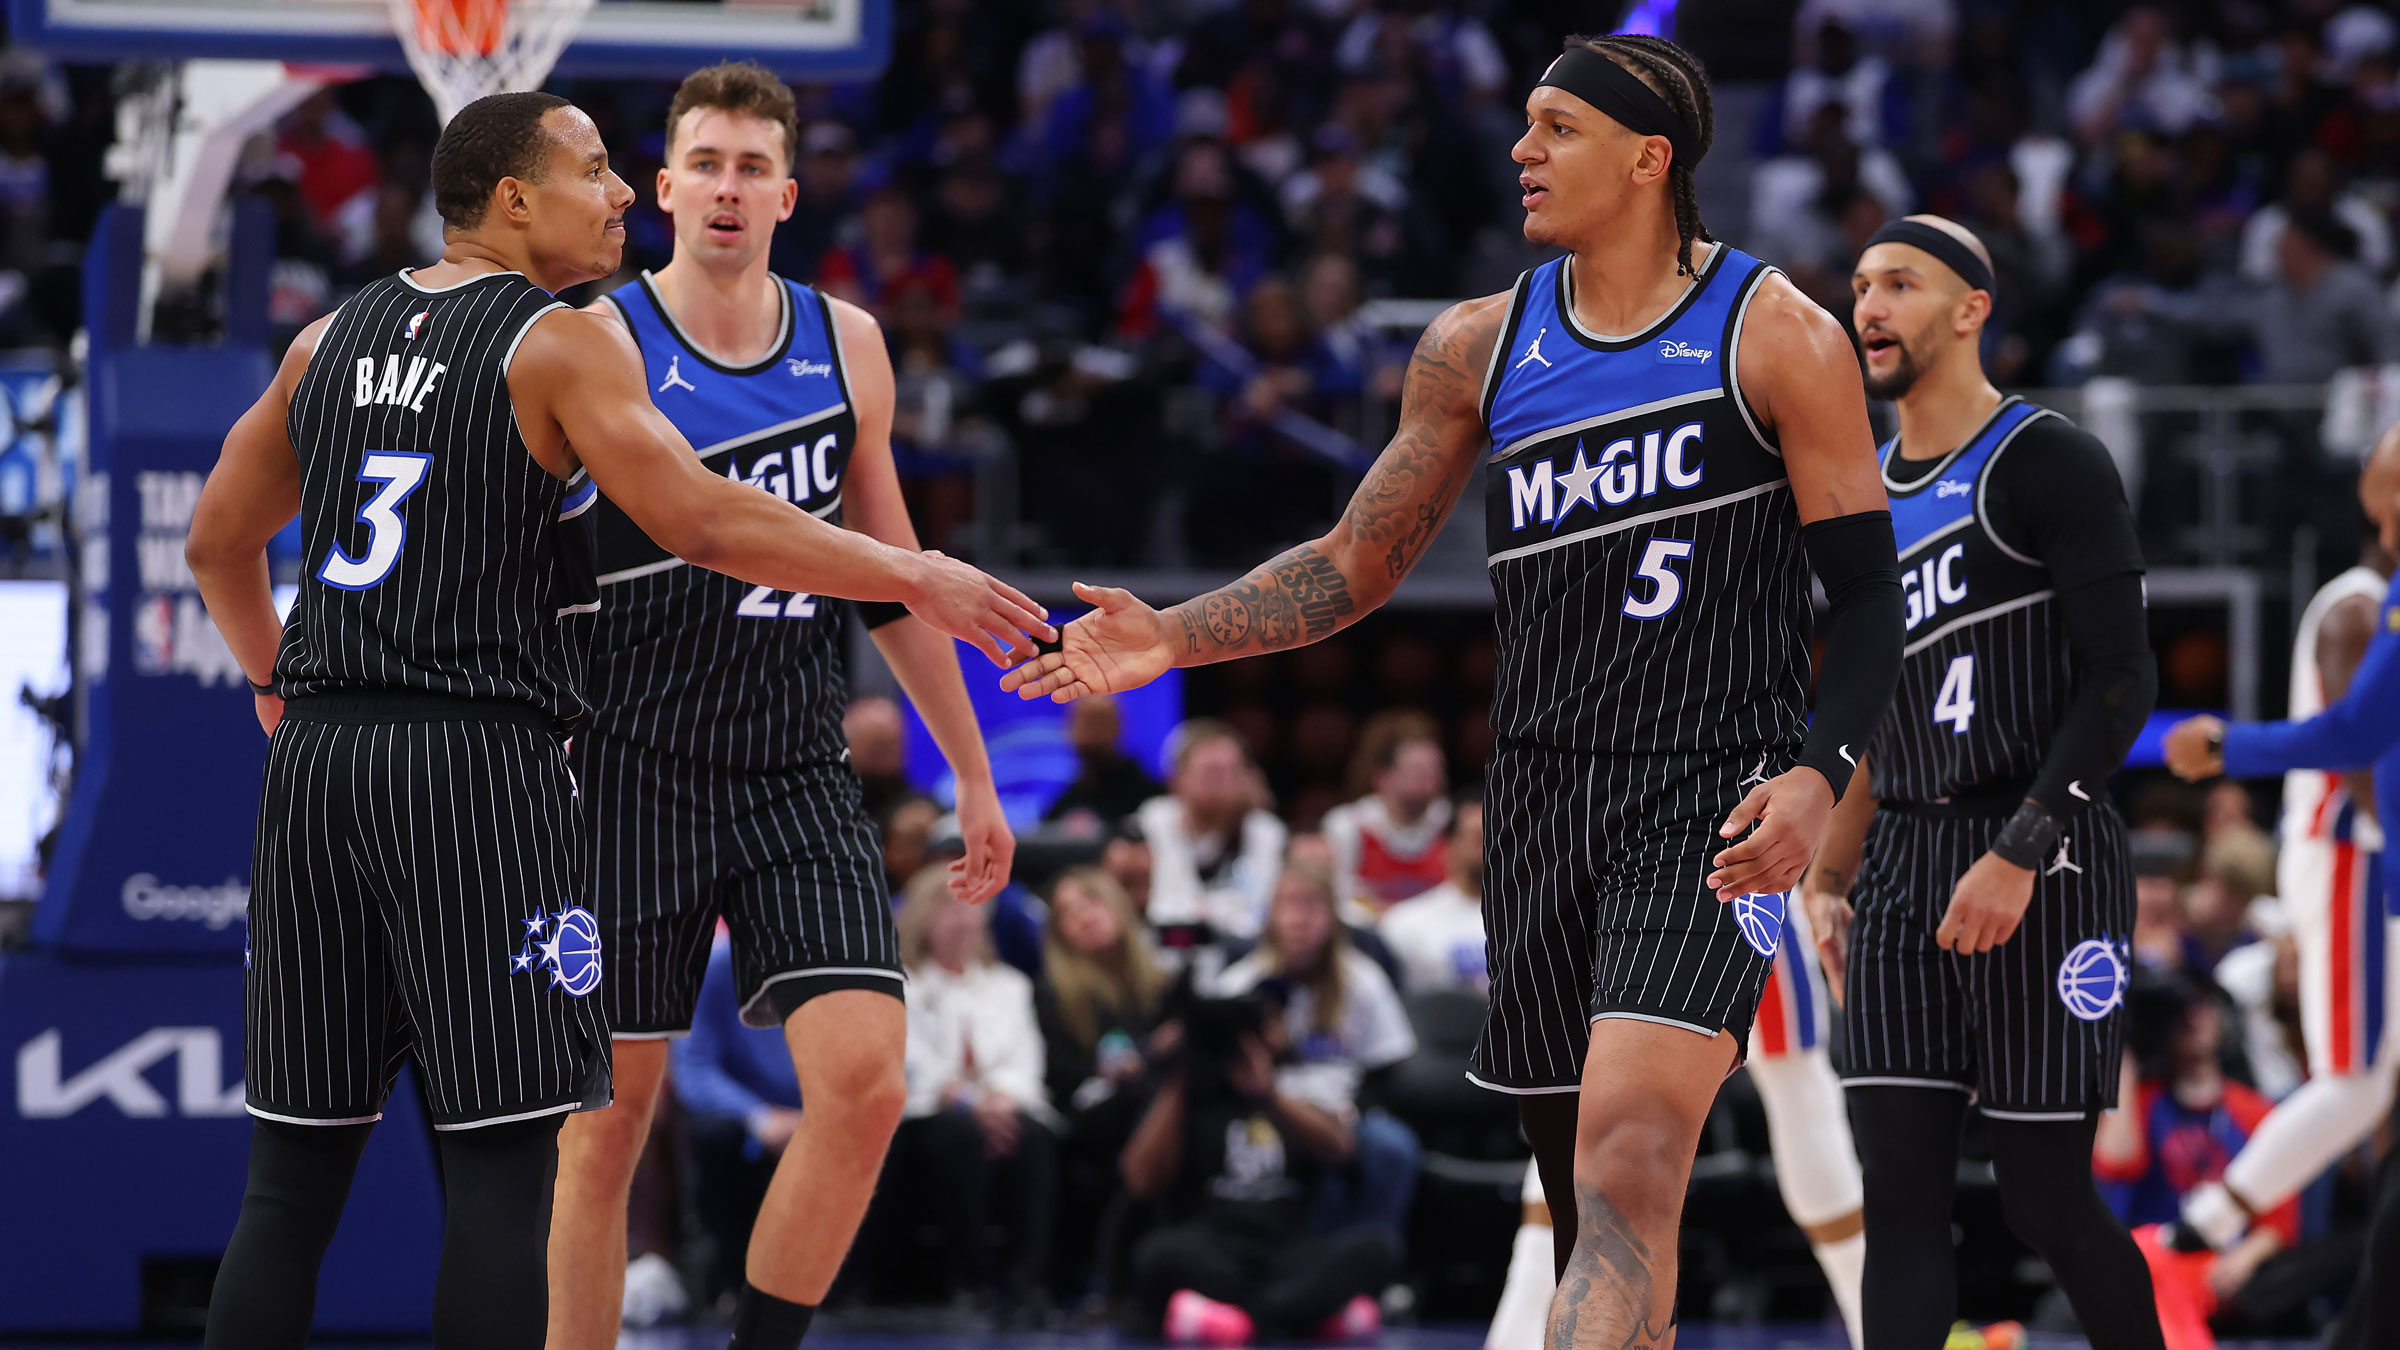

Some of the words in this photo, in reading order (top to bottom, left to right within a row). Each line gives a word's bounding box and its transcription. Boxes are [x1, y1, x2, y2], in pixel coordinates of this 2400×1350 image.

[355, 354, 447, 413] BANE
[785, 358, 832, 379] Disney
[1659, 340, 1713, 364] Disney
[1505, 421, 1704, 533] MAGIC
[315, 449, 434, 591] 3
[1620, 537, 1696, 620] 5
[1901, 542, 1968, 632] GIC
[1932, 653, 1976, 735] 4
